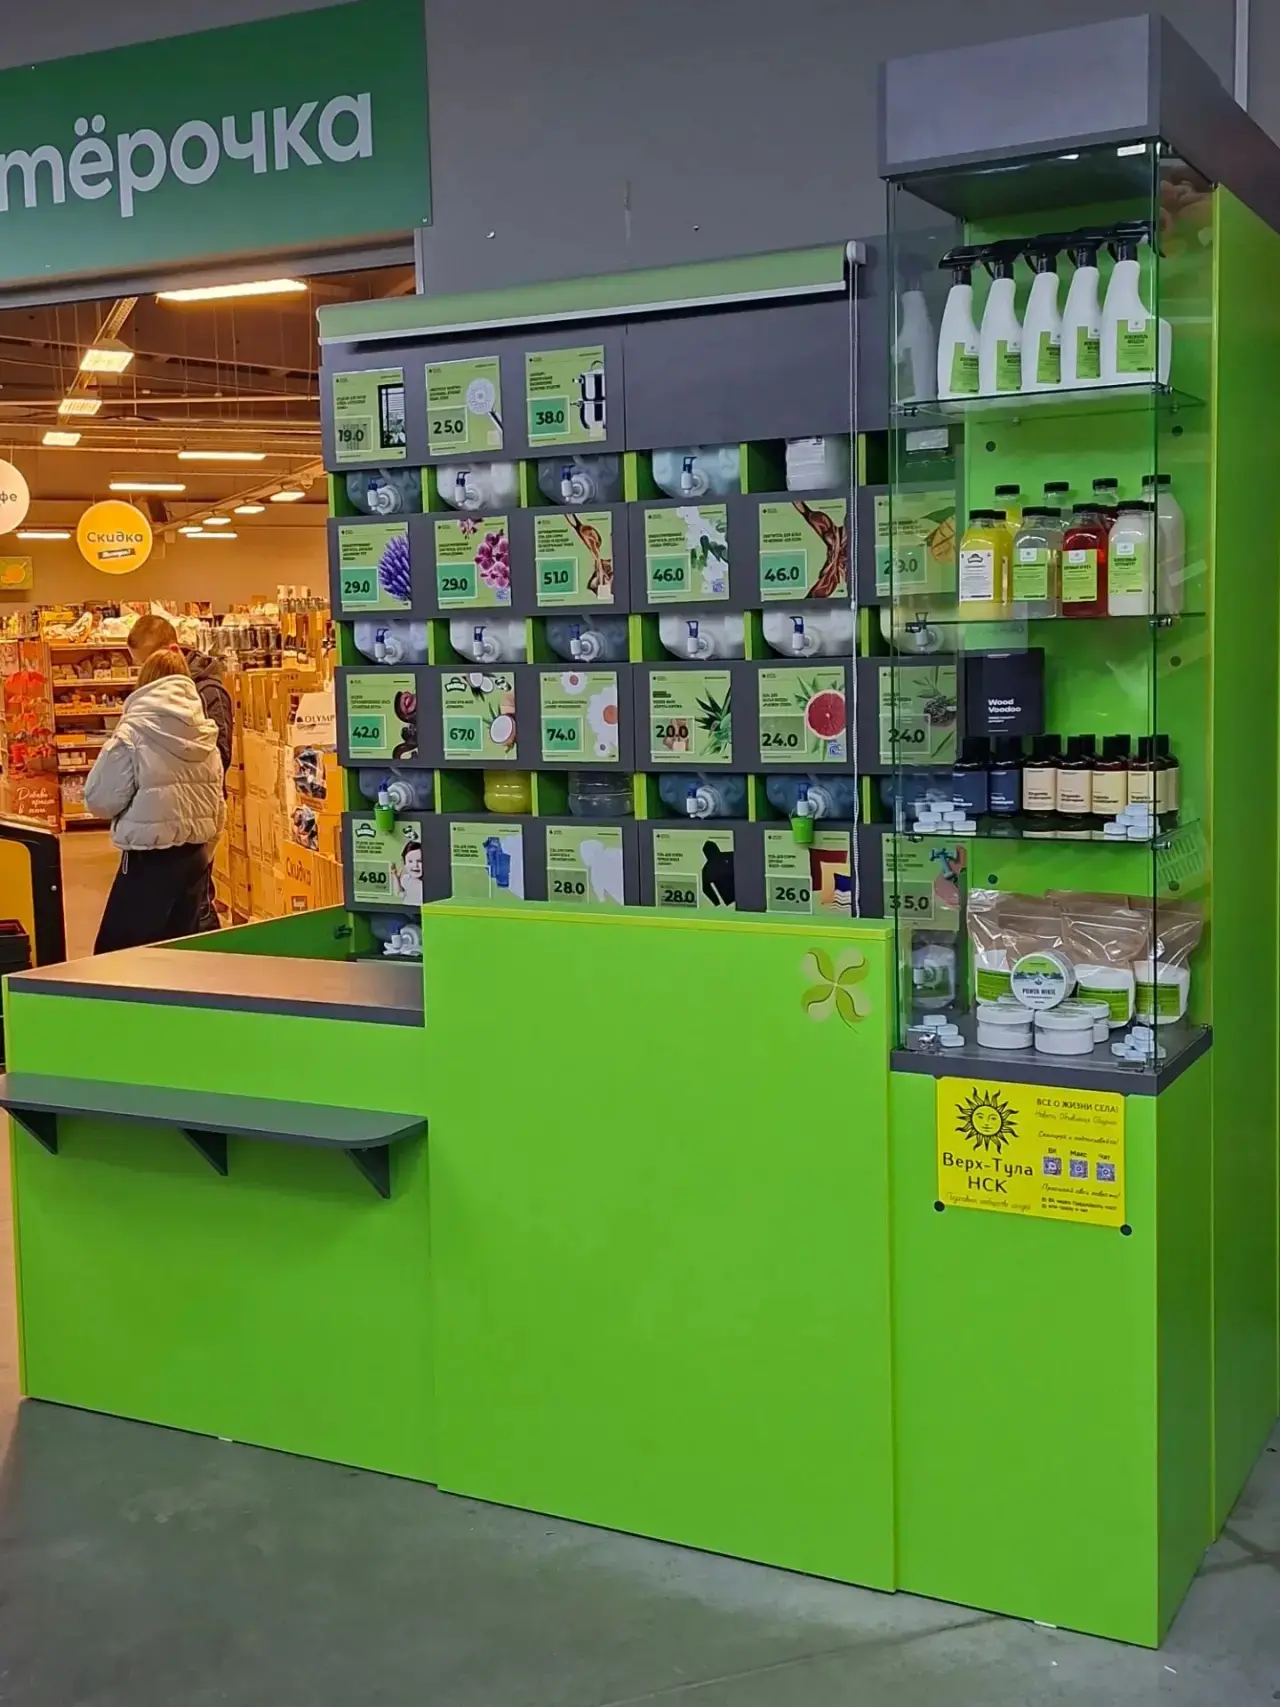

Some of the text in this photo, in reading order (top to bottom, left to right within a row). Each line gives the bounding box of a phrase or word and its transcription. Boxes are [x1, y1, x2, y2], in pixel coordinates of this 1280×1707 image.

[0, 92, 373, 218] тёрочка
[652, 567, 685, 582] 46.0
[763, 566, 800, 582] 46.0
[344, 579, 371, 594] 29.0
[442, 577, 469, 592] 29.0
[987, 698, 1015, 706] Wood
[546, 727, 576, 741] 74.0
[655, 724, 689, 739] 20.0
[761, 732, 799, 747] 24.0
[553, 879, 586, 895] 28.0
[1069, 1149, 1088, 1158] Макс
[942, 1151, 1034, 1178] Верх-Тула
[967, 1175, 1008, 1194] НСК
